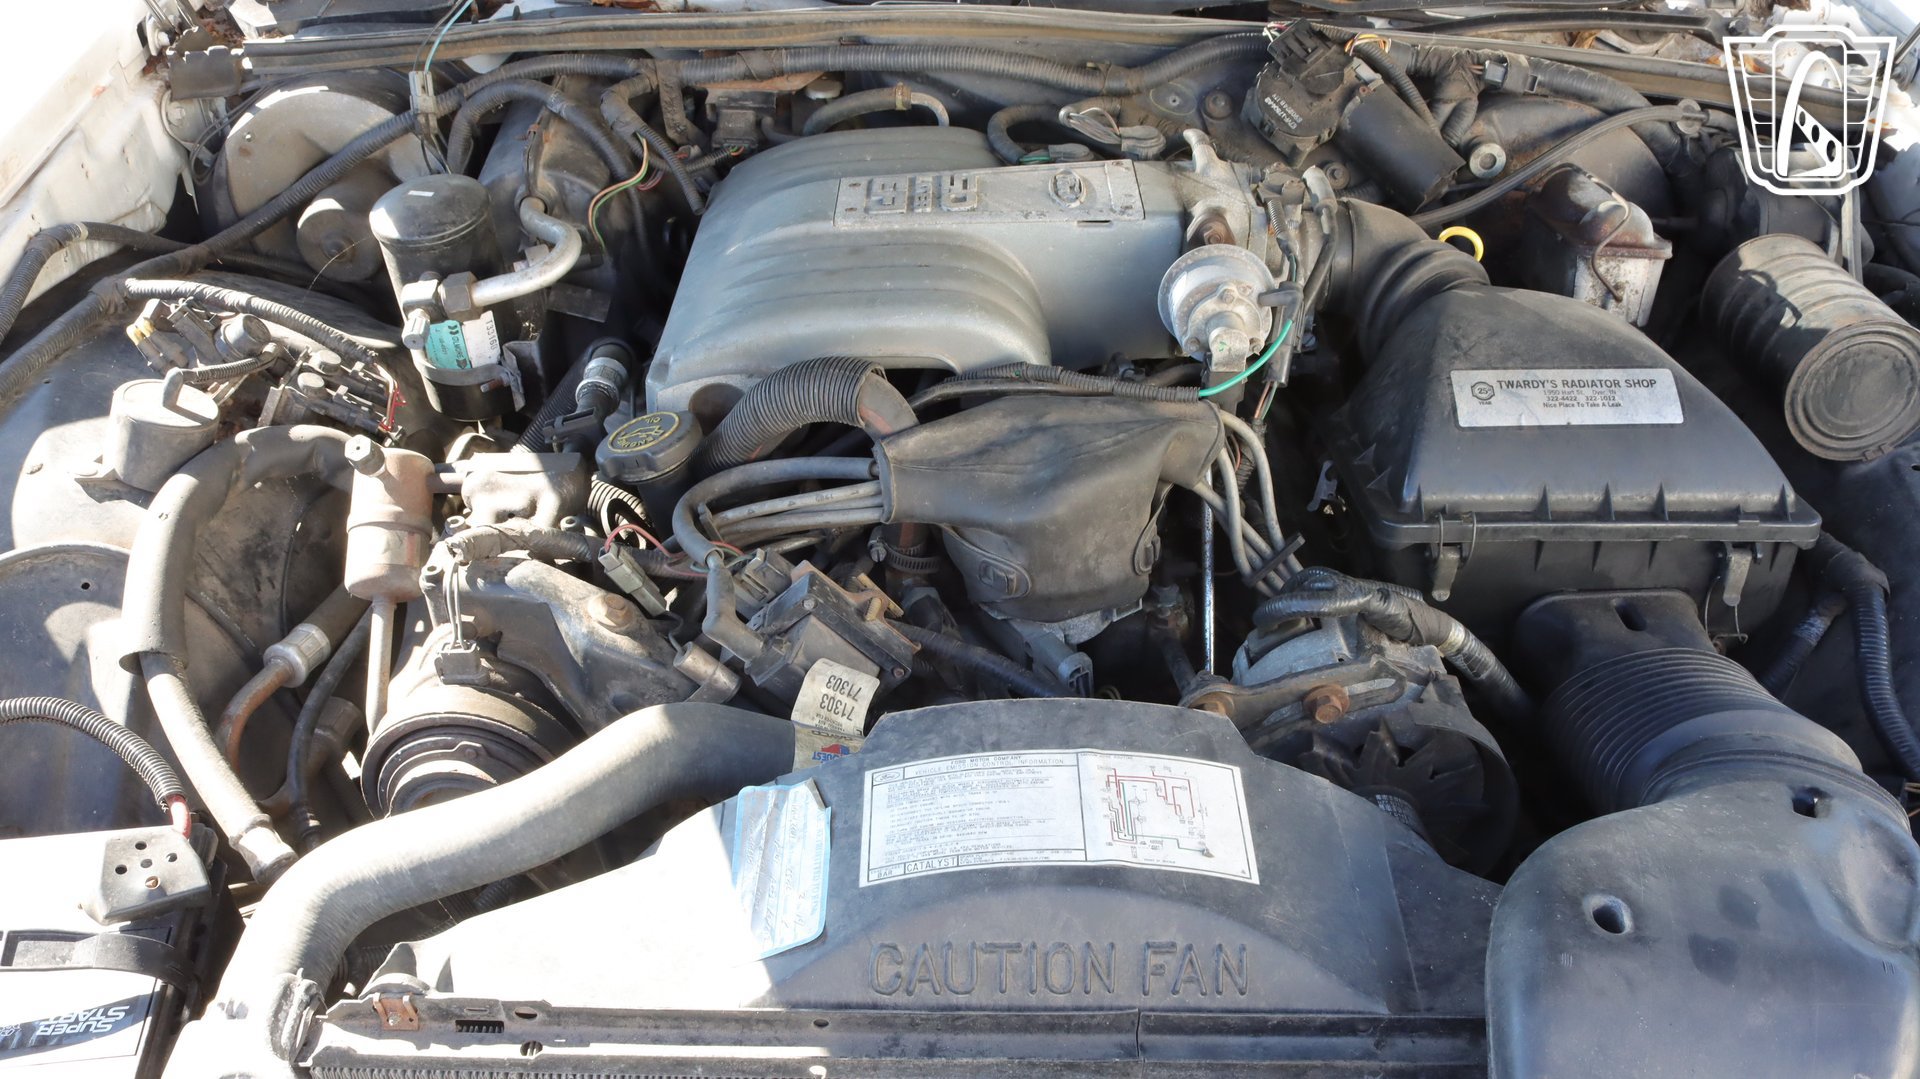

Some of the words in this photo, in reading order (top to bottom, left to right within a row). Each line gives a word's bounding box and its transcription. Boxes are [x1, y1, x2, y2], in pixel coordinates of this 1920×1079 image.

[1497, 379, 1558, 389] TWARDY'S
[1562, 379, 1621, 389] RADIATOR
[1625, 379, 1657, 388] SHOP
[643, 416, 661, 424] OIL
[825, 674, 863, 702] 71303
[819, 693, 856, 722] 71303
[914, 767, 942, 775] VEHICLE
[945, 763, 979, 772] EMISSION
[981, 760, 1014, 768] CONTROL
[906, 856, 957, 872] CATALYST
[867, 940, 1117, 997] CAUTION
[1142, 940, 1249, 997] FAN
[39, 1005, 130, 1026] START
[36, 1020, 113, 1035] SUPER
